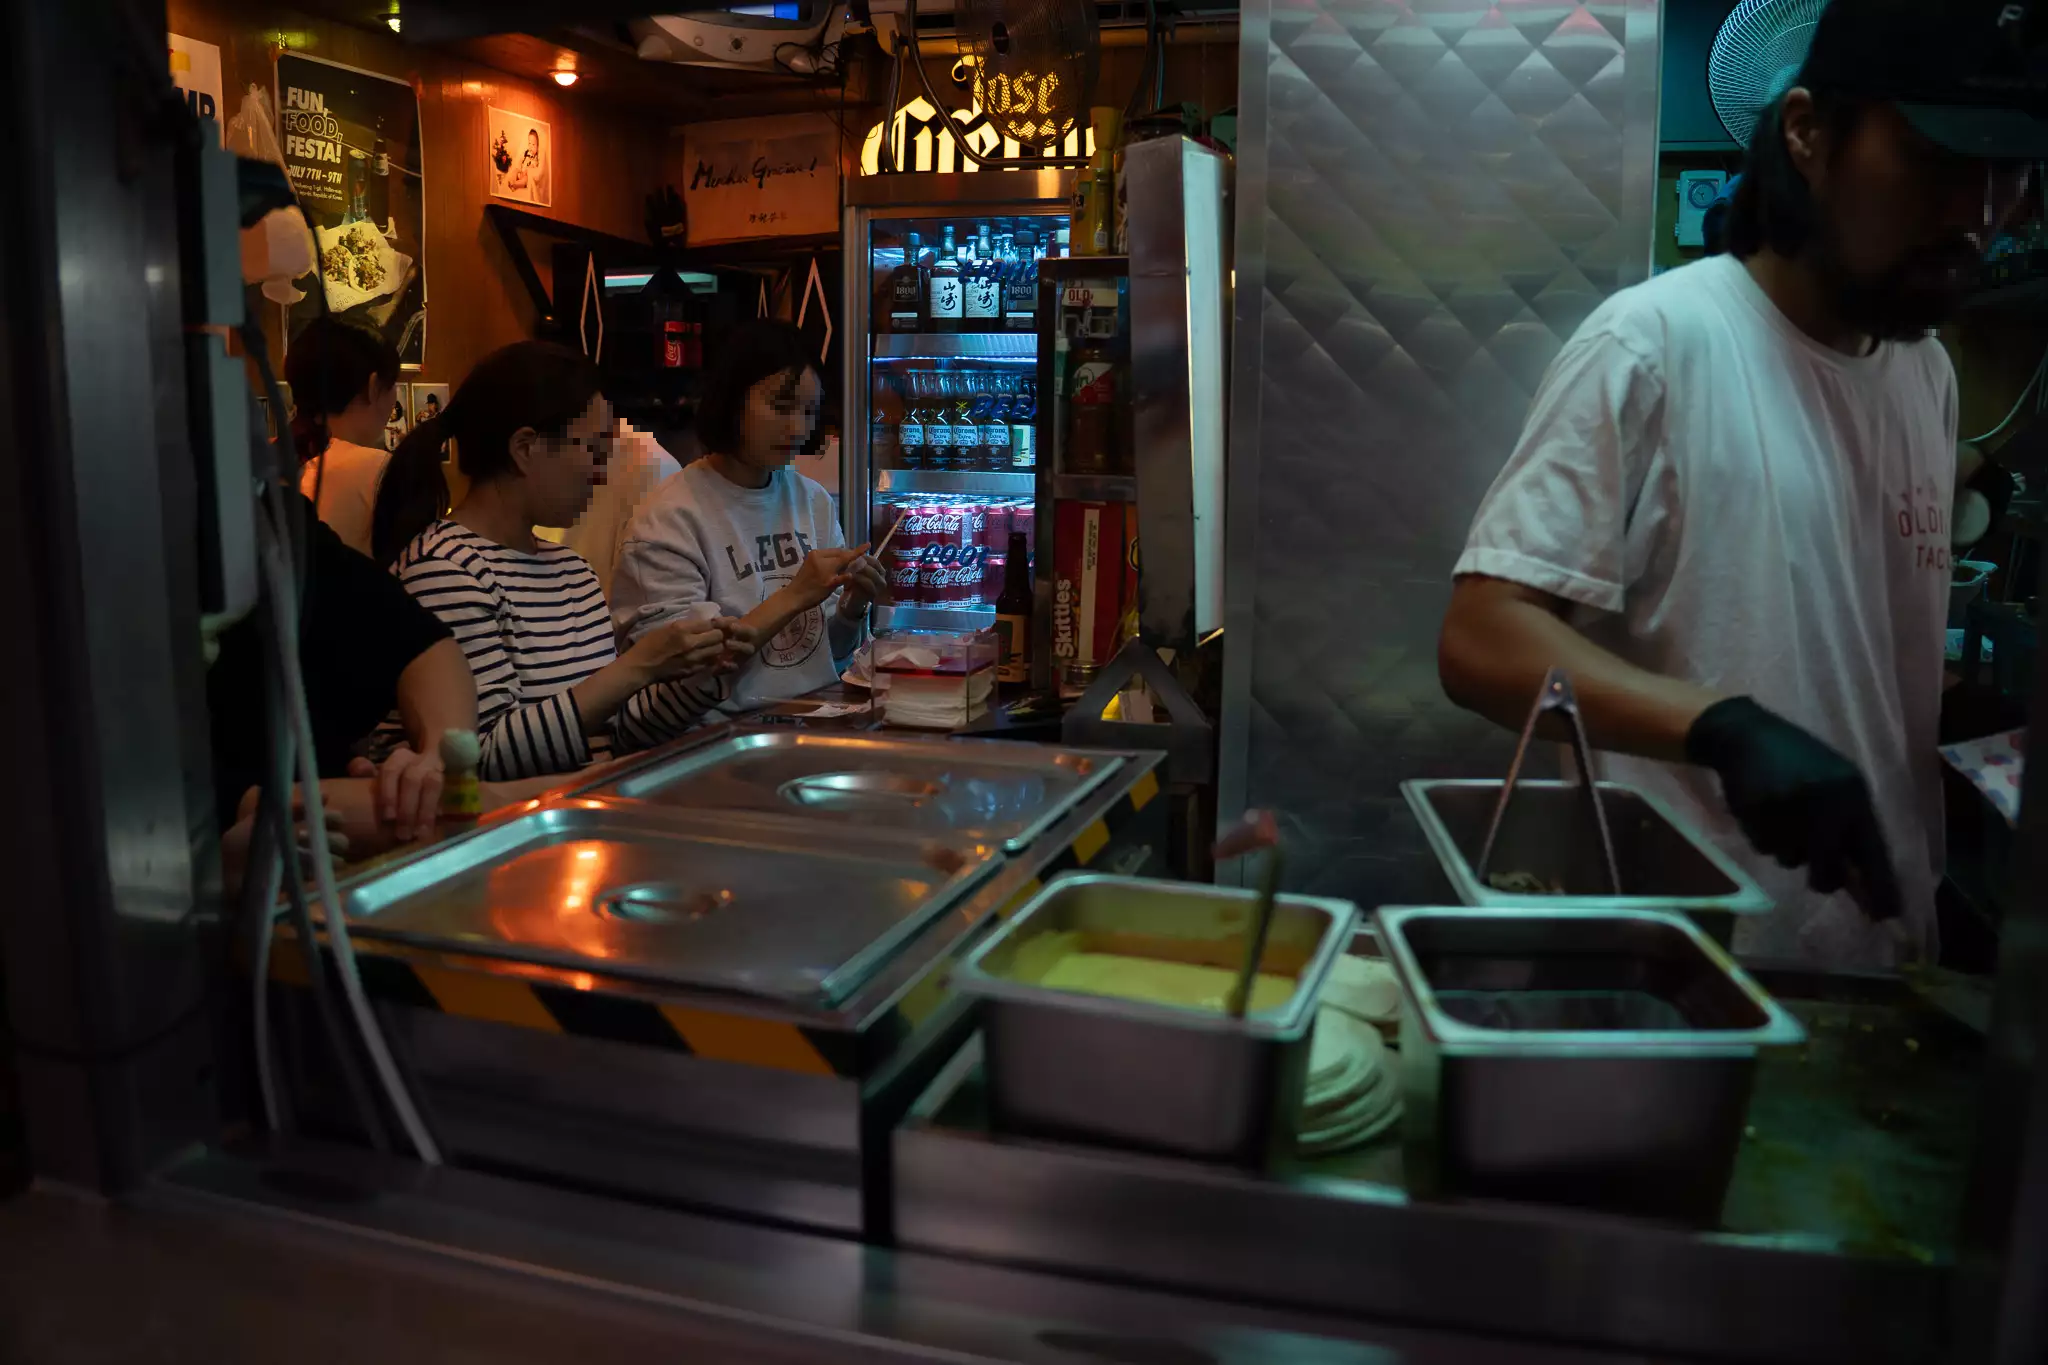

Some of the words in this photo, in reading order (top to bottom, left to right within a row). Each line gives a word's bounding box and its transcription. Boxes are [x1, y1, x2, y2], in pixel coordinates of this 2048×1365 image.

[287, 87, 329, 117] FUN,
[286, 109, 343, 143] FOOD,
[286, 134, 342, 164] FESTA!
[1011, 285, 1032, 295] 1800
[1054, 578, 1075, 658] Skittles
